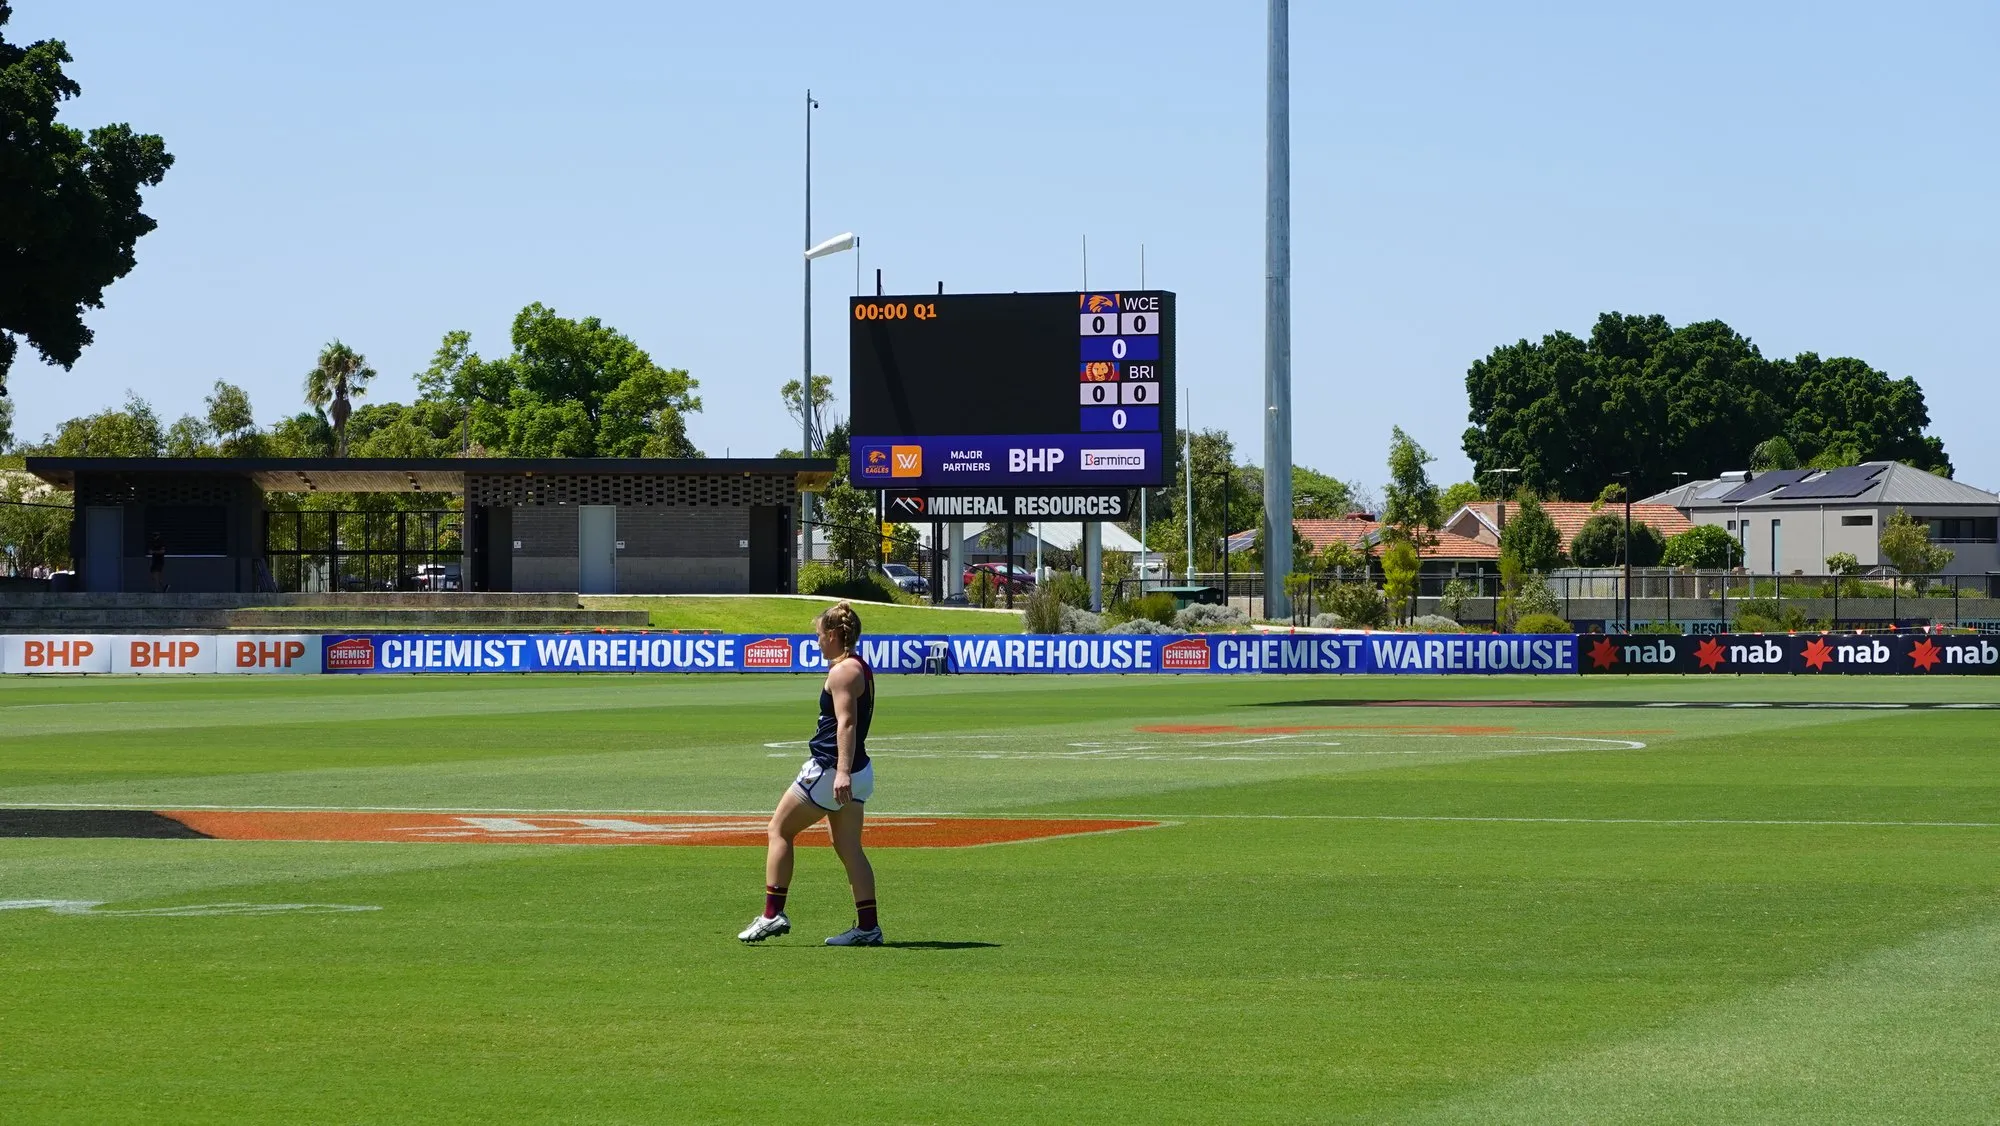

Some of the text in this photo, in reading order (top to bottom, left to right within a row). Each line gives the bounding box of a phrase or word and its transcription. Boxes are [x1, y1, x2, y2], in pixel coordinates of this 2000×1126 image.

[855, 303, 937, 320] 00:00 Q1
[1124, 297, 1159, 311] WCE
[1092, 315, 1147, 333] 0 0
[1112, 339, 1127, 359] 0
[1129, 366, 1154, 379] BRI
[1092, 385, 1147, 403] 0 0
[1112, 409, 1127, 430] 0
[950, 450, 983, 460] MAJOR
[1009, 448, 1065, 472] BHP
[1085, 453, 1141, 466] Barminco
[943, 463, 991, 472] PARTNERS
[927, 496, 1122, 516] MINERAL RESOURCES
[24, 641, 94, 667] BHP
[130, 641, 200, 667] BHP
[236, 641, 306, 667] BHP
[330, 650, 371, 659] CHEMIST
[381, 639, 734, 668] CHEMIST WAREHOUSE
[747, 649, 789, 658] CHEMIST
[800, 640, 1152, 668] CMIST WAREHOUSE
[1166, 649, 1207, 659] CHEMIST
[1218, 640, 1572, 669] CHEMIST WAREHOUSE
[1624, 639, 1676, 663] nab
[1731, 640, 1783, 664] nab
[1838, 640, 1890, 663] nab
[1946, 640, 1999, 664] nab
